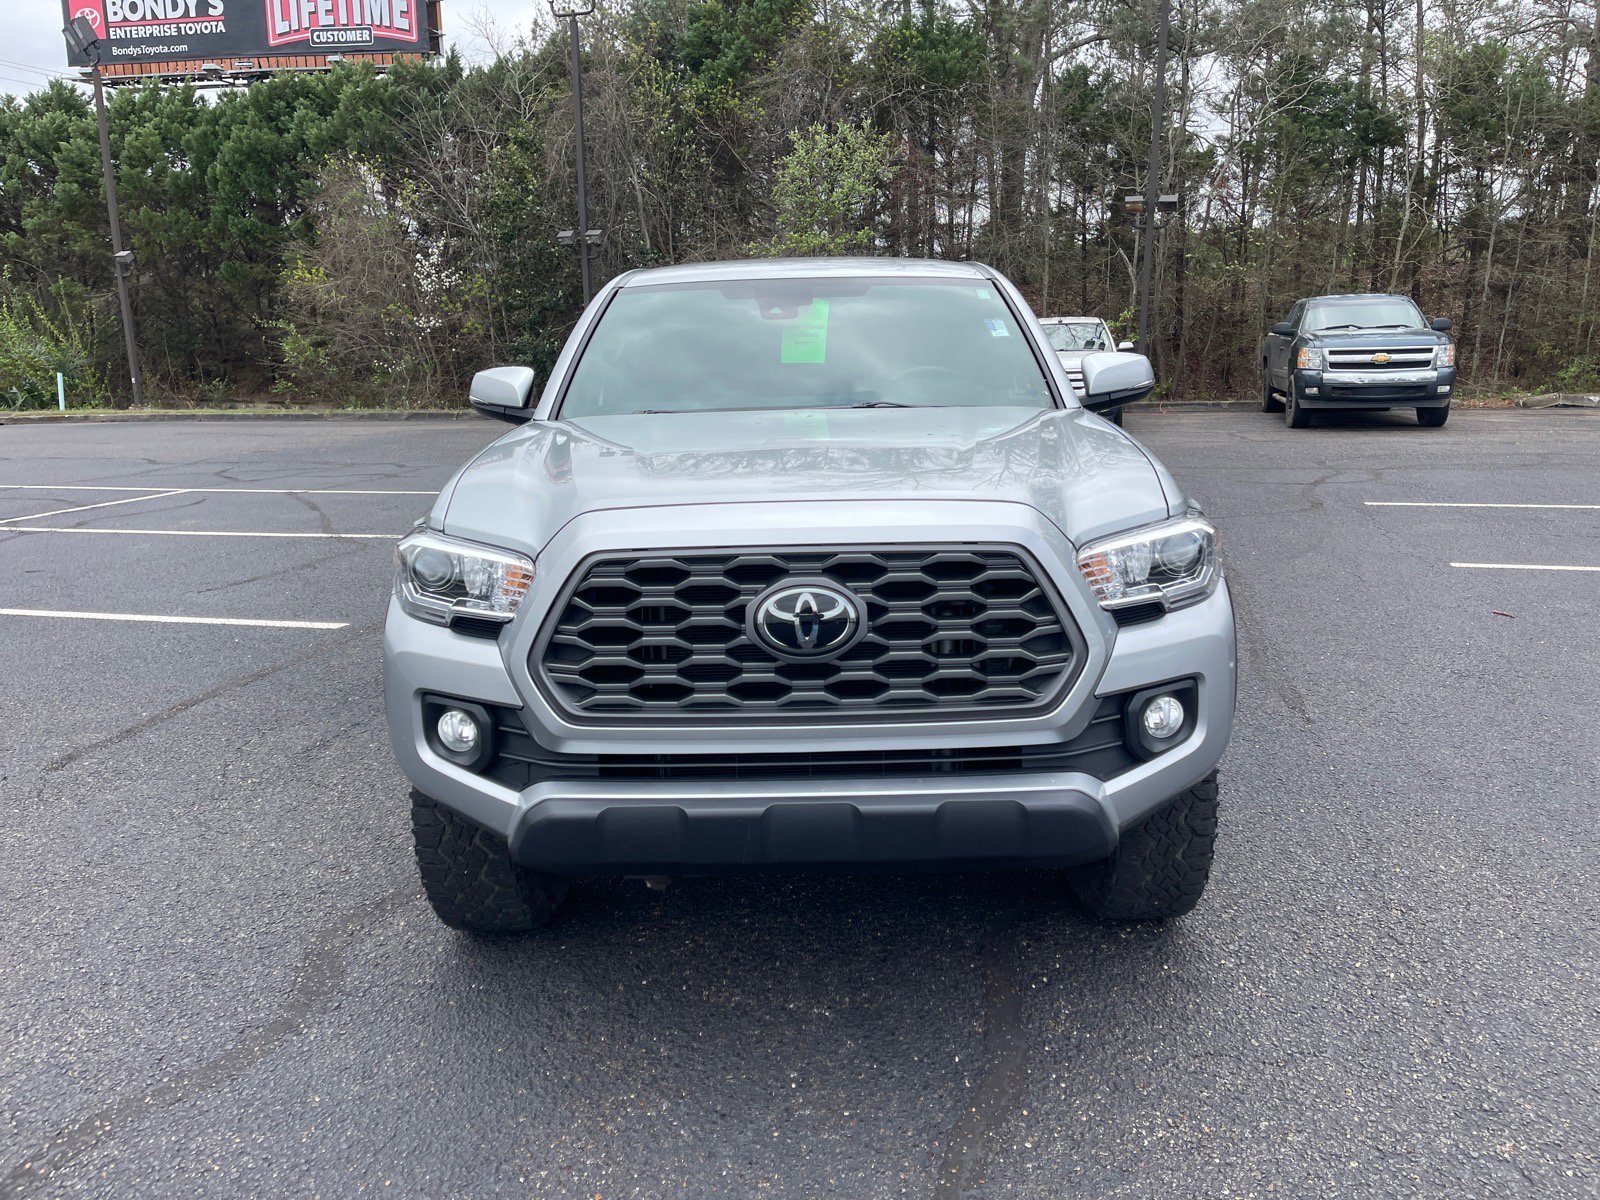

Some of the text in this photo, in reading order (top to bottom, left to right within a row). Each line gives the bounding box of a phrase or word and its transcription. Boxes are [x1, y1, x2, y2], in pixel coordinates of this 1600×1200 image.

[106, 0, 224, 22] BONDYS
[272, 0, 410, 34] LIFETIME
[109, 21, 226, 39] ENTERPRISE TOYOTA
[313, 30, 370, 43] CUSTOMER
[112, 45, 188, 56] BondysToyota.com
